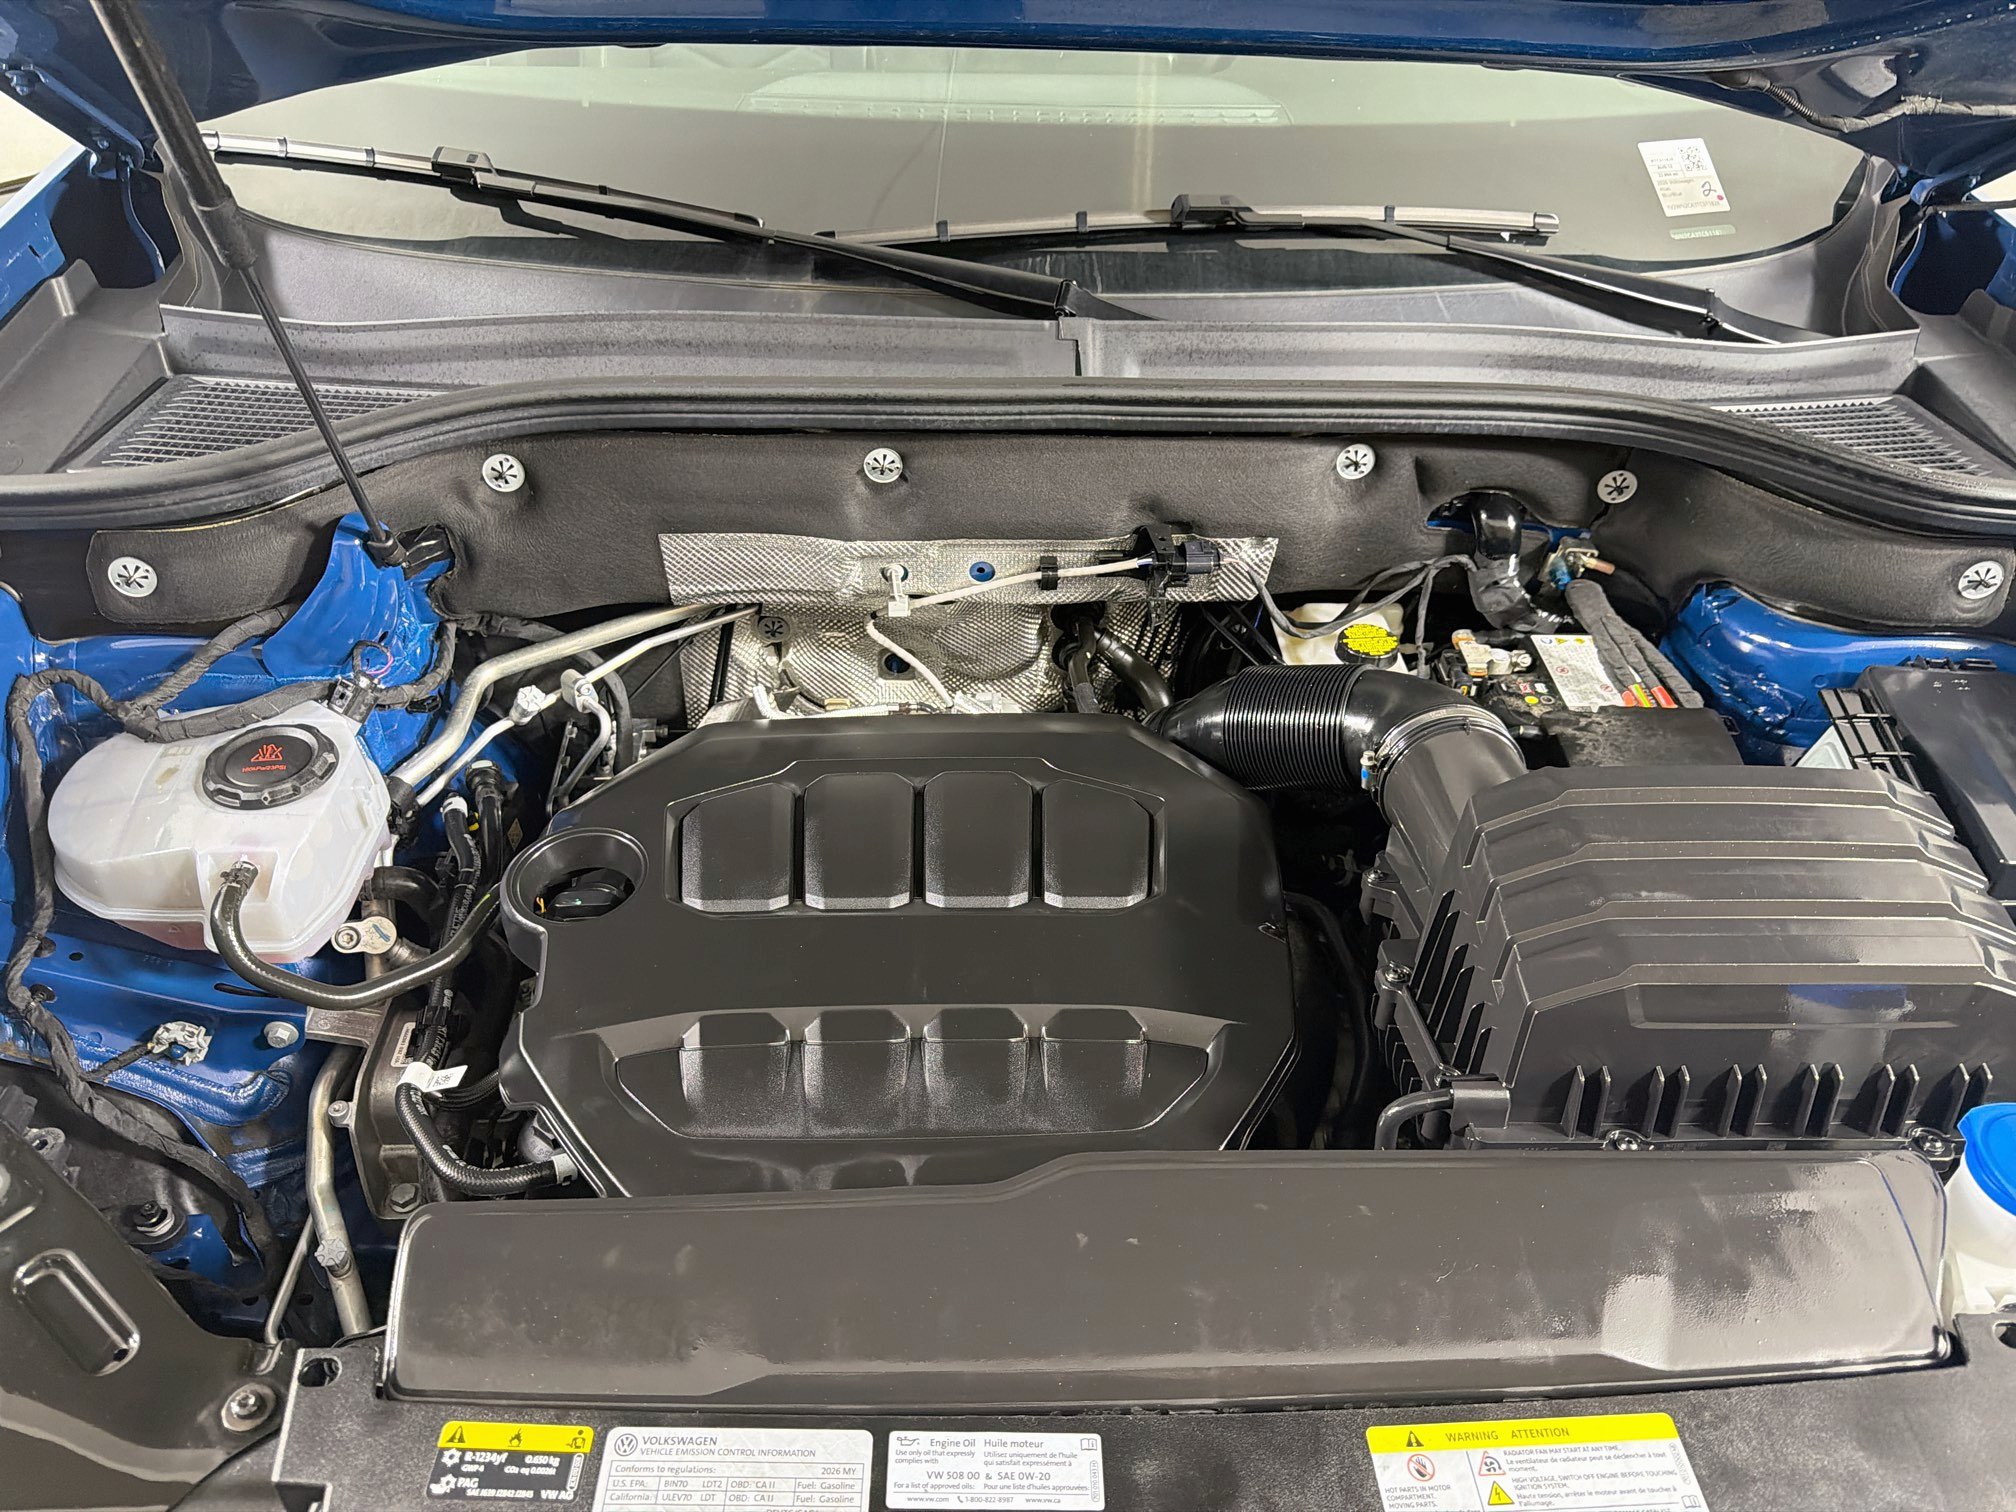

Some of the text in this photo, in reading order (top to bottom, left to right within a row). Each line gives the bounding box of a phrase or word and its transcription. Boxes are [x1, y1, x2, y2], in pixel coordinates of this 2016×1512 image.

[1701, 181, 1717, 197] 2
[1445, 1427, 1569, 1442] WARNING ATTENTION
[642, 1436, 718, 1446] VOLKSWAGEN
[930, 1438, 976, 1449] Engine Oil
[984, 1439, 1008, 1448] Huile
[675, 1448, 715, 1456] EMISSION
[758, 1449, 816, 1457] INFORMATION
[908, 1449, 922, 1457] only
[946, 1450, 975, 1459] expressly
[1009, 1452, 1047, 1460] uniquement
[464, 1451, 560, 1467] R-1234yf 0.650 kg
[895, 1457, 922, 1465] complies
[615, 1465, 857, 1475] Conforms to regulations: 2026 MY
[926, 1471, 944, 1480] VW
[946, 1471, 964, 1480] 508
[967, 1471, 980, 1480] 00
[997, 1472, 1016, 1480] SAE
[1018, 1472, 1051, 1481] 0W-20
[1558, 1474, 1582, 1482] SWITCH
[457, 1477, 479, 1488] PAG
[630, 1480, 648, 1488] EPA:
[664, 1480, 688, 1488] BIN70
[702, 1480, 723, 1488] LDT2
[730, 1481, 751, 1489] OBD:
[820, 1482, 856, 1490] Gasoline
[930, 1482, 961, 1490] approved
[1428, 1484, 1451, 1492] MOTOR
[540, 1489, 574, 1500] VW AG
[610, 1493, 652, 1501] California:
[700, 1494, 716, 1502] LDT
[728, 1494, 749, 1502] OBD:
[796, 1495, 816, 1503] Fuel:
[819, 1495, 855, 1503] Gasoline
[1388, 1501, 1415, 1509] MOVING
